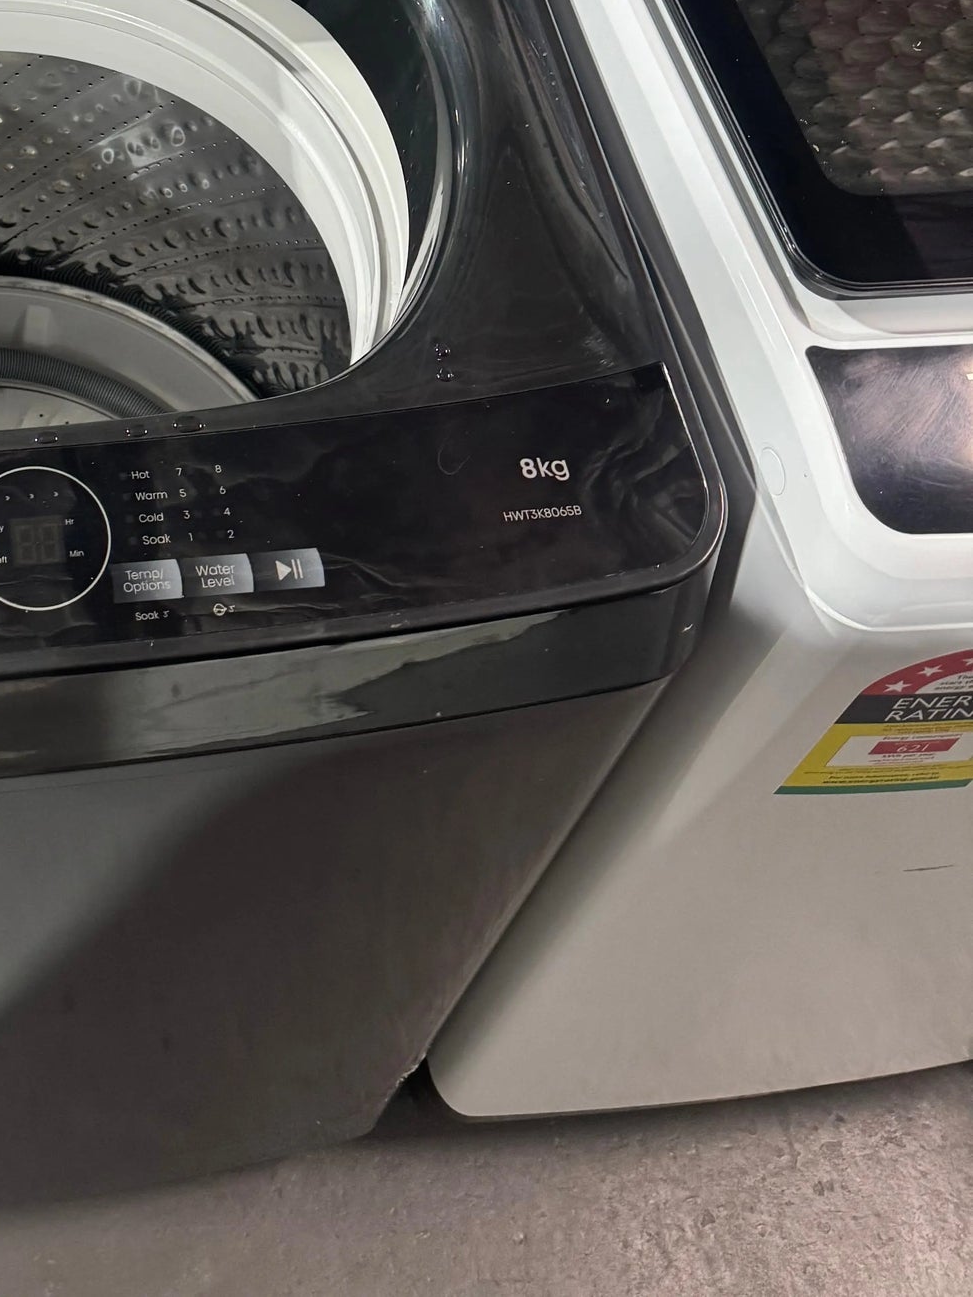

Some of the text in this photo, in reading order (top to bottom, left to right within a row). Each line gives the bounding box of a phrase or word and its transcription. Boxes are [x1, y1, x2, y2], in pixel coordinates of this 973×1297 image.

[175, 467, 182, 477] 7
[214, 464, 222, 474] 8
[519, 457, 570, 481] 8kg
[131, 470, 150, 480] Hot
[178, 488, 187, 498] 5
[219, 485, 227, 495] 6
[135, 490, 168, 501] Warm
[182, 510, 191, 520] 3
[223, 507, 231, 516] 4
[138, 512, 164, 523] Cold
[142, 533, 171, 545] Soak
[188, 532, 193, 542] 1
[227, 529, 235, 539] 2
[69, 549, 84, 557] Min
[125, 568, 164, 582] Temp/
[195, 564, 235, 577] Water
[123, 580, 171, 593] Options
[201, 575, 235, 588] Level
[135, 611, 159, 621] Soak
[892, 695, 973, 709] ENER
[896, 744, 929, 753] 621
